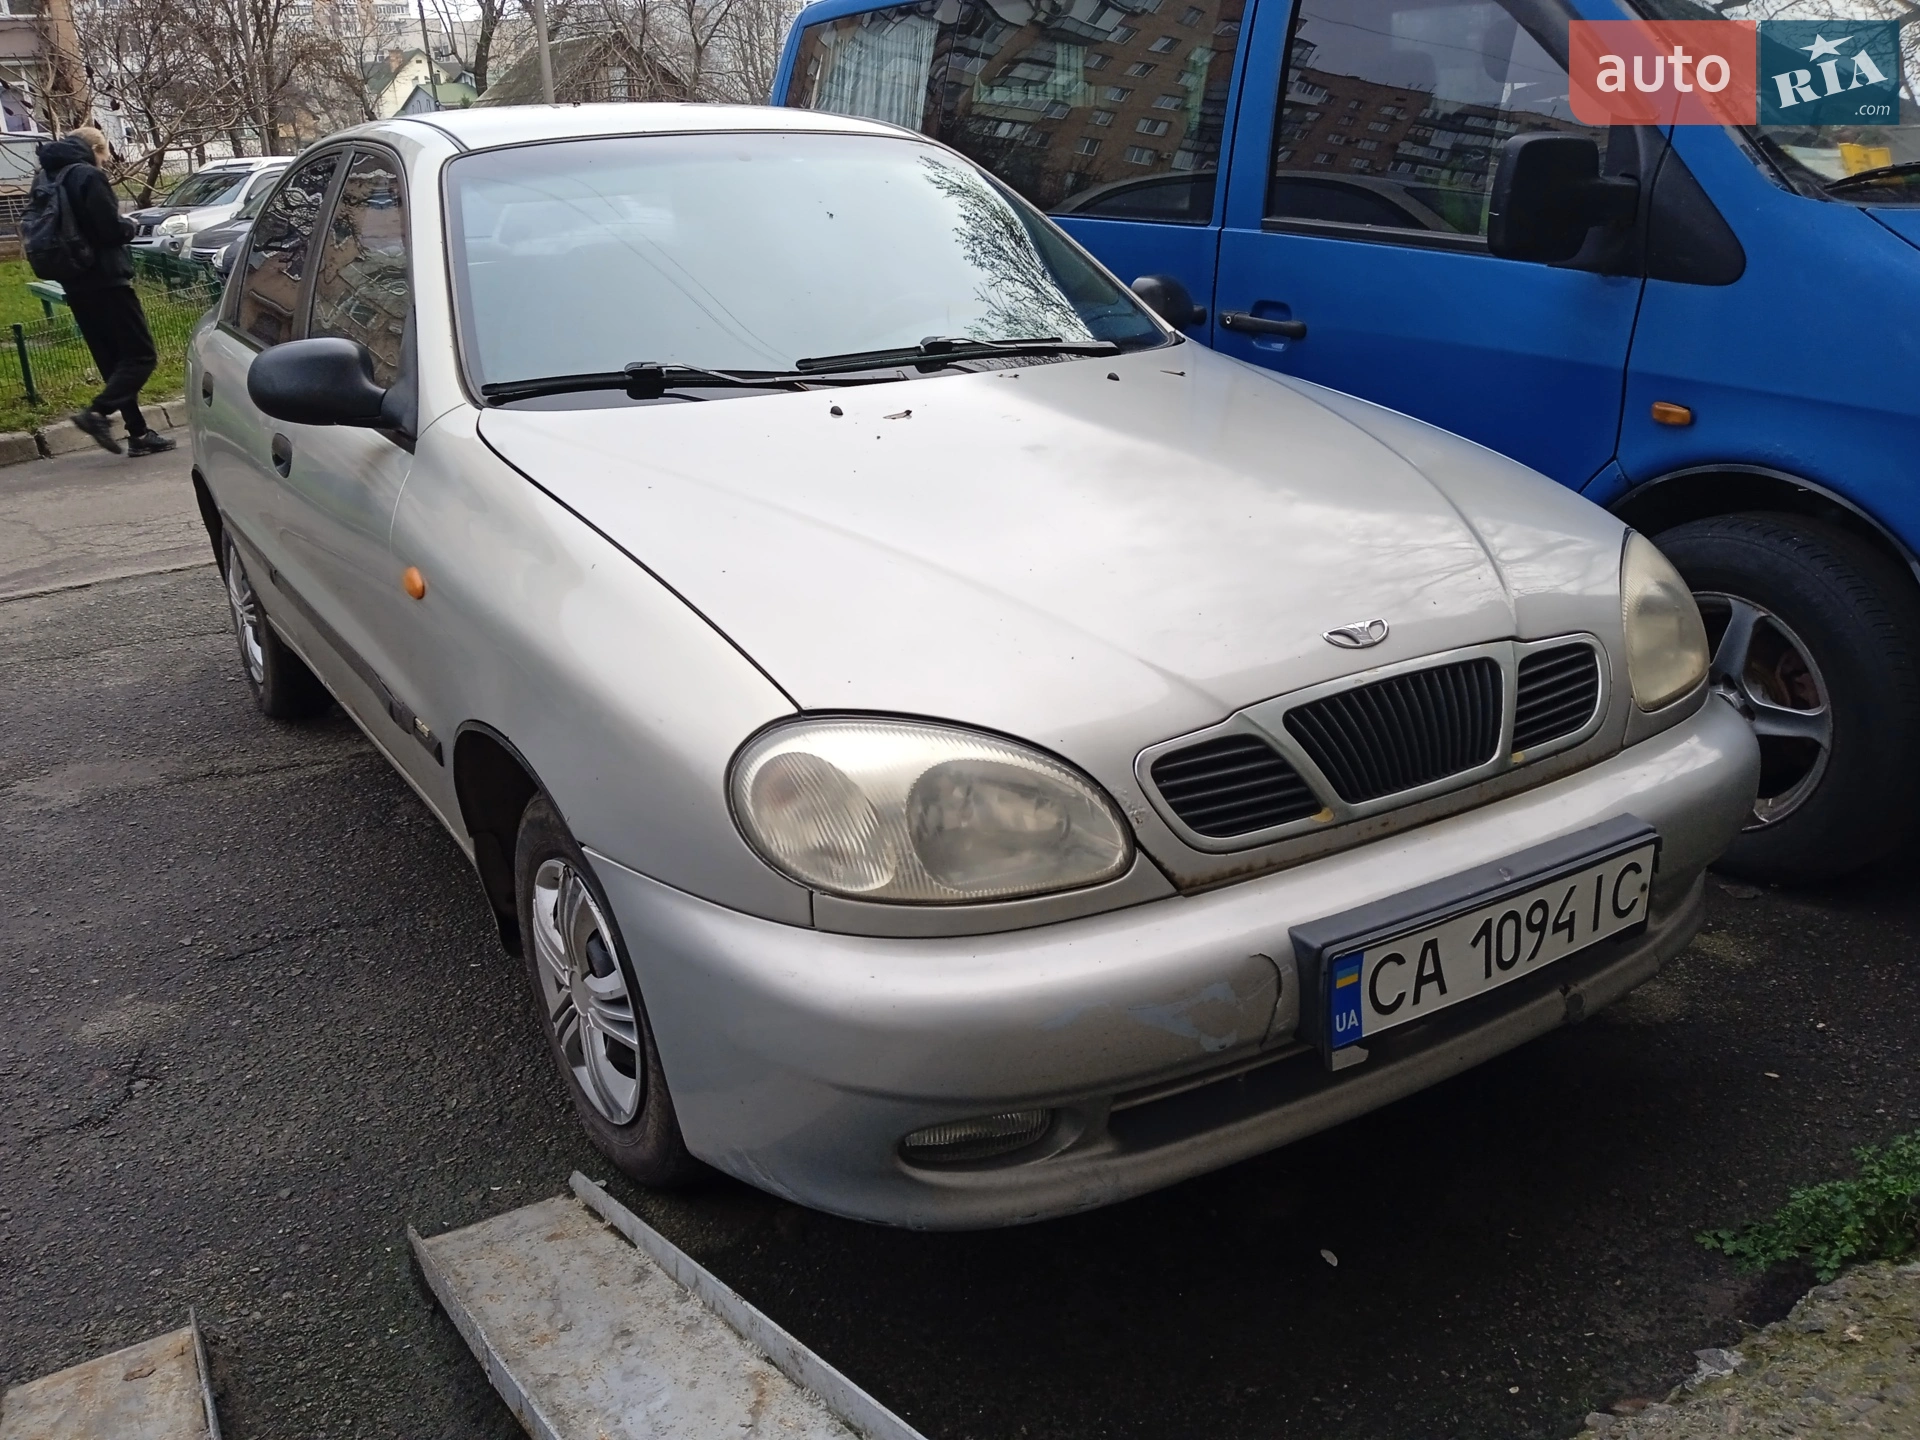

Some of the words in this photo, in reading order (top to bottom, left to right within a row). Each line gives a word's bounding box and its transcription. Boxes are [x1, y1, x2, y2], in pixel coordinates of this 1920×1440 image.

[1368, 938, 1448, 1016] CA
[1470, 884, 1577, 980] 1094
[1593, 862, 1643, 932] IC
[1335, 1009, 1360, 1033] UA
